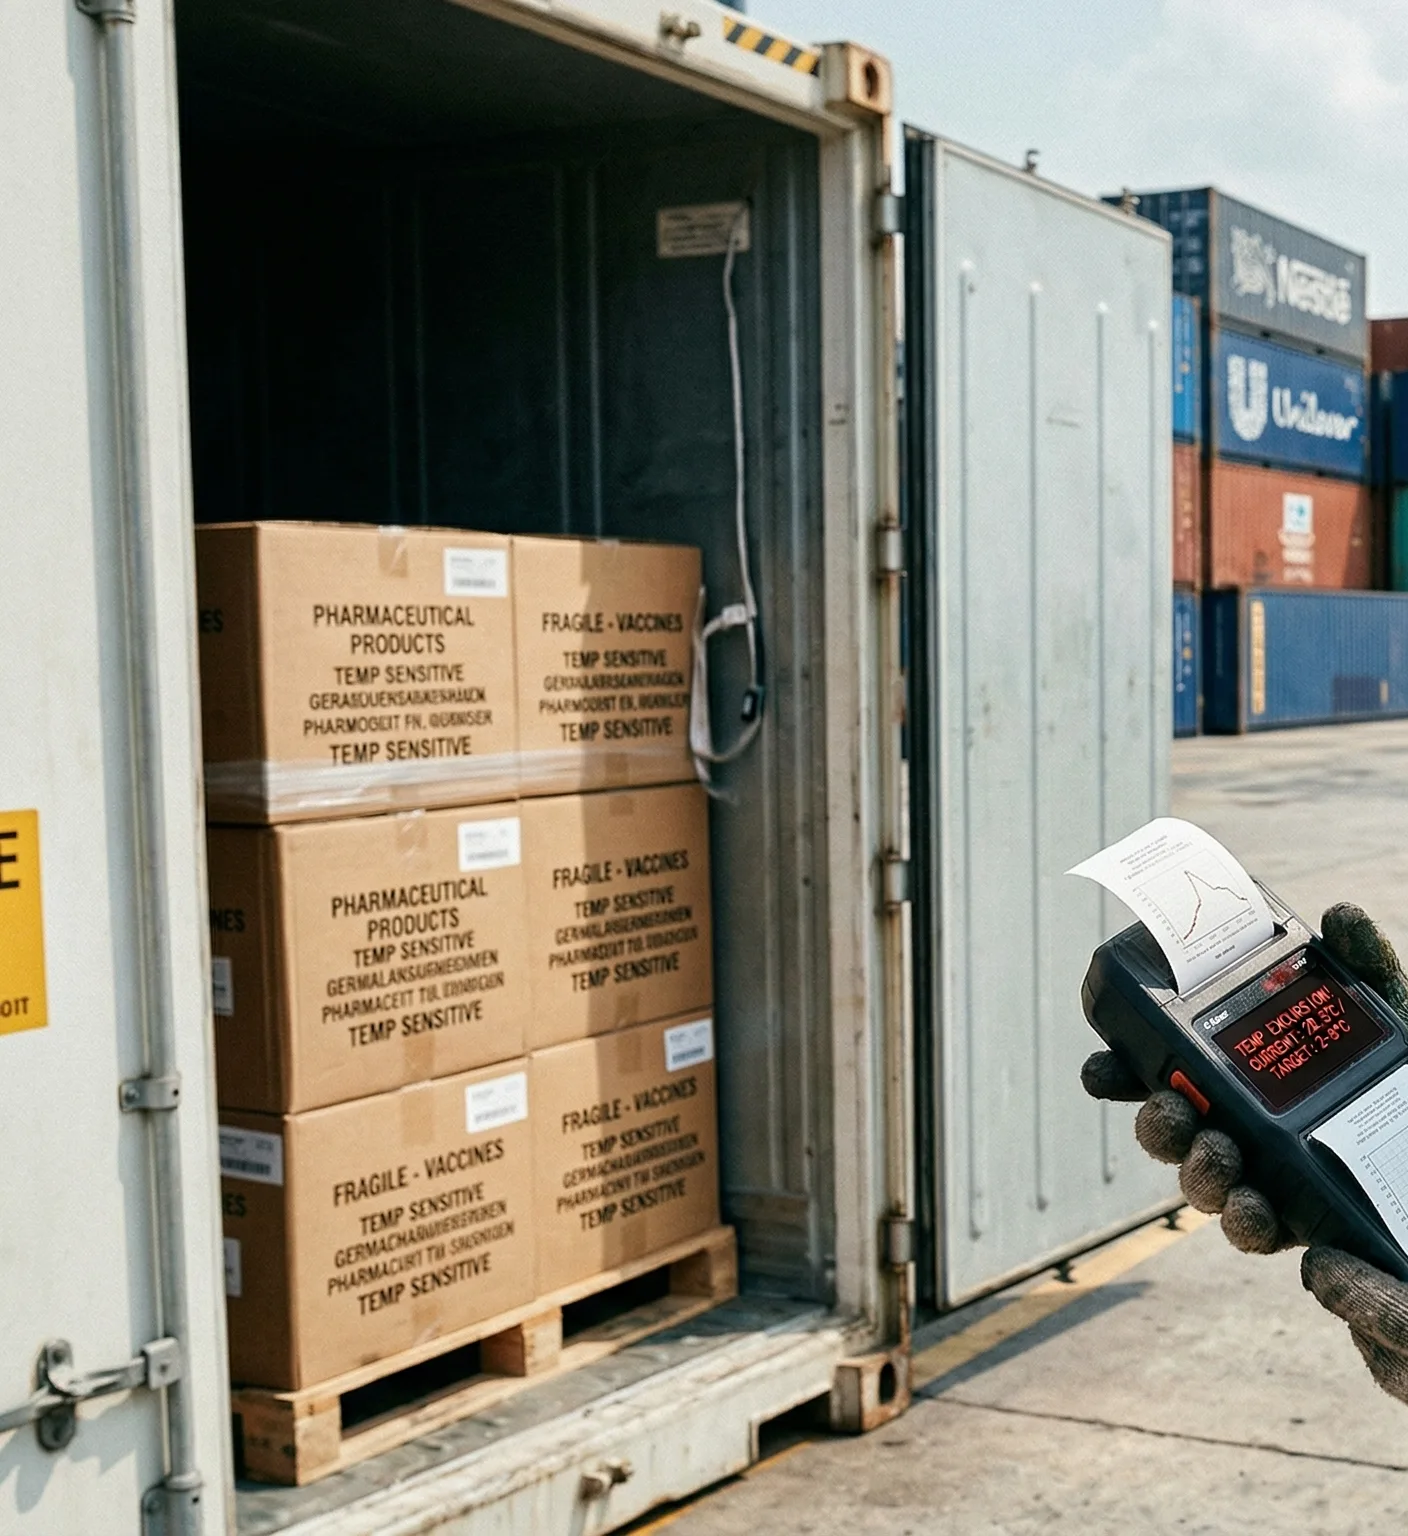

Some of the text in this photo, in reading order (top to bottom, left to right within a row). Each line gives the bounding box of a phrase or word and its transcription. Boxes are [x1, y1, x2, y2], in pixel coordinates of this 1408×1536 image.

[313, 604, 475, 627] PHARMACEUTICAL
[542, 612, 604, 633] FRAGILE
[616, 611, 684, 633] VACCINES
[351, 634, 446, 655] PRODUCTS
[563, 649, 667, 668] TEMP SENSITIVE
[334, 663, 464, 685] TEMP SENSITIVE
[559, 716, 673, 742] TEMP SENSITIVE
[329, 735, 472, 767] TEMP SENSITIVE
[552, 860, 613, 890] FRAGILE
[624, 848, 690, 879] VACCINES
[331, 876, 488, 918] PHARMACEUTICAL
[574, 885, 675, 918] TEMP SENSITIVE
[367, 906, 460, 941] PRODUCTS
[353, 930, 475, 969] TEMP SENSITIVE
[571, 951, 680, 992] TEMP SENSITIVE
[348, 999, 483, 1047] TEMP SENSITIVE
[1234, 1030, 1264, 1057] TEMP
[1269, 1019, 1351, 1080] TARGET: 2-8°C
[562, 1098, 622, 1134] FRAGILE
[633, 1075, 699, 1113] VACCINES
[580, 1135, 618, 1161] TEMP
[620, 1114, 681, 1149] SENSITIVE
[332, 1165, 409, 1208] FRAGILE
[424, 1138, 505, 1180] VACCINES
[359, 1207, 404, 1236] TEMP
[409, 1181, 486, 1221] SENSITIVE
[579, 1202, 618, 1232] TEMP
[620, 1177, 686, 1218] SENSITIVE
[357, 1252, 492, 1316] TEMP SENSITIVE
